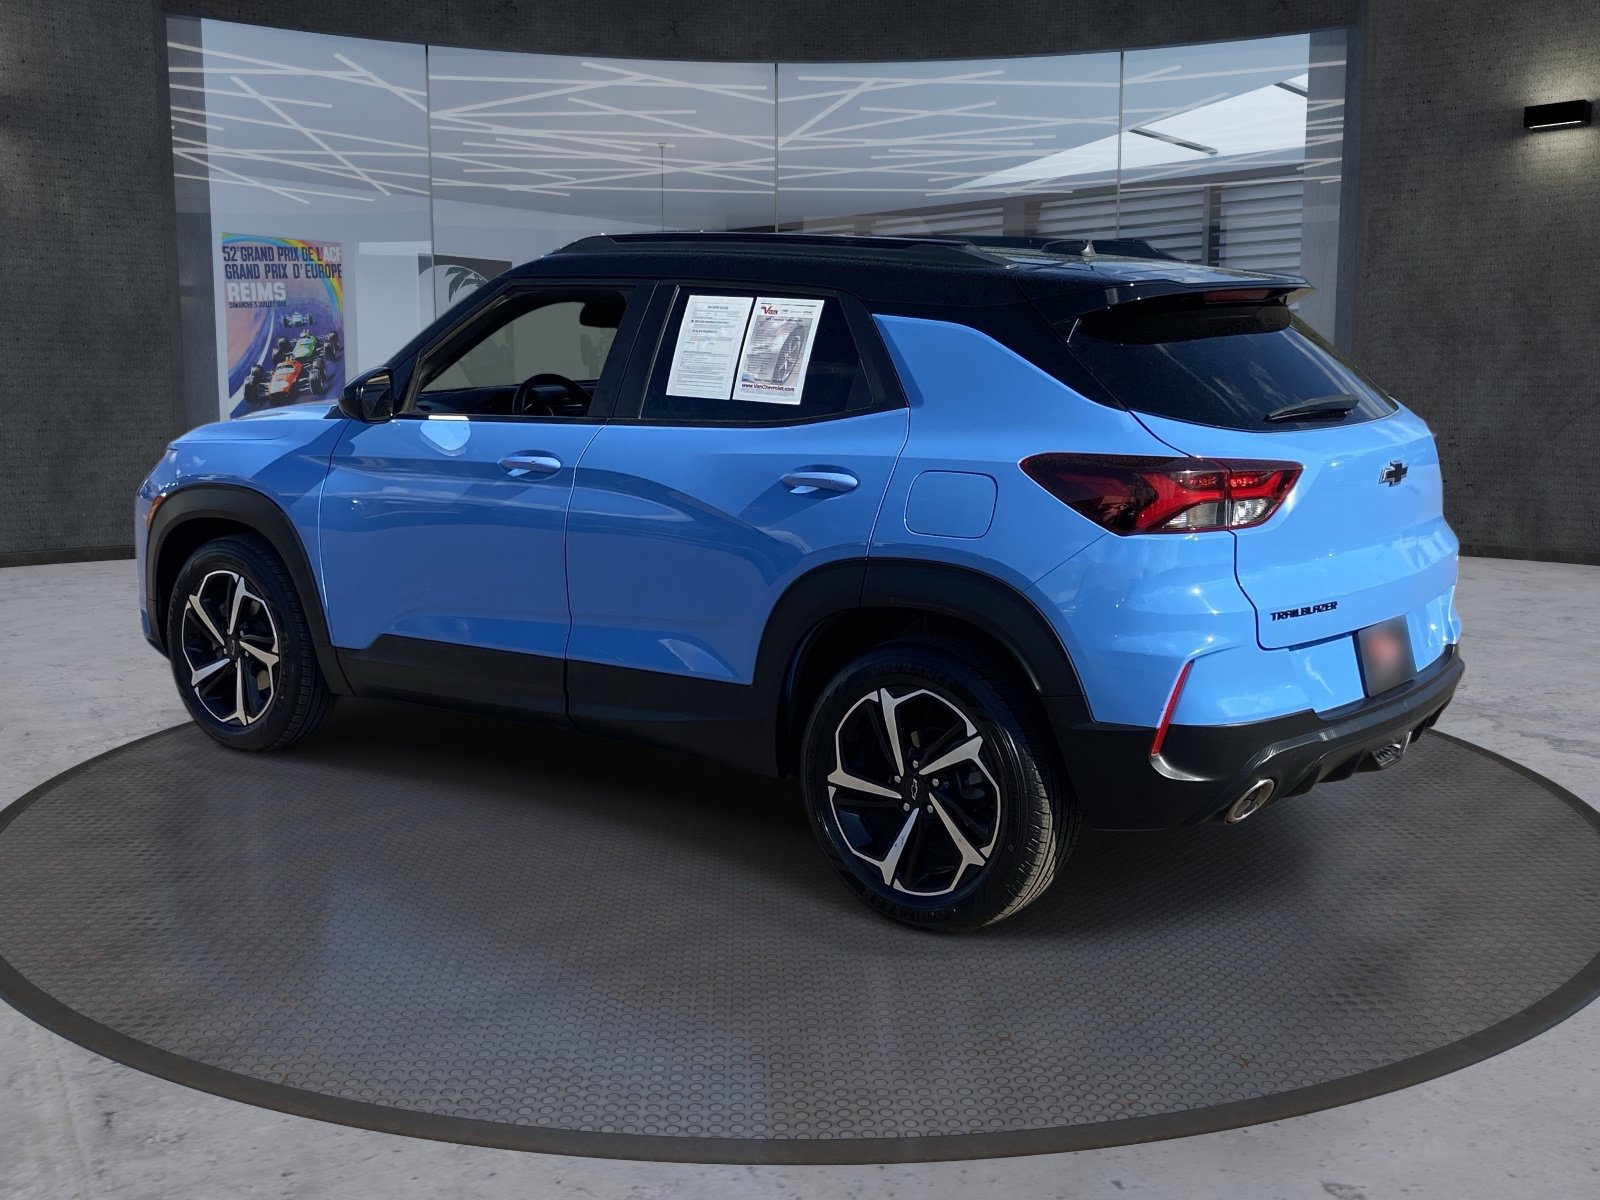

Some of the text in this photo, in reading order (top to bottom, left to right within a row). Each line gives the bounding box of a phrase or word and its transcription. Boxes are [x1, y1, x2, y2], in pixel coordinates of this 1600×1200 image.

[241, 246, 275, 262] GRAND
[277, 246, 301, 262] PRIX
[302, 247, 314, 262] DE
[225, 264, 260, 280] GRAND
[264, 264, 288, 279] PRIX
[226, 282, 287, 302] REIMS
[1270, 601, 1338, 622] TRAILBLAZER
